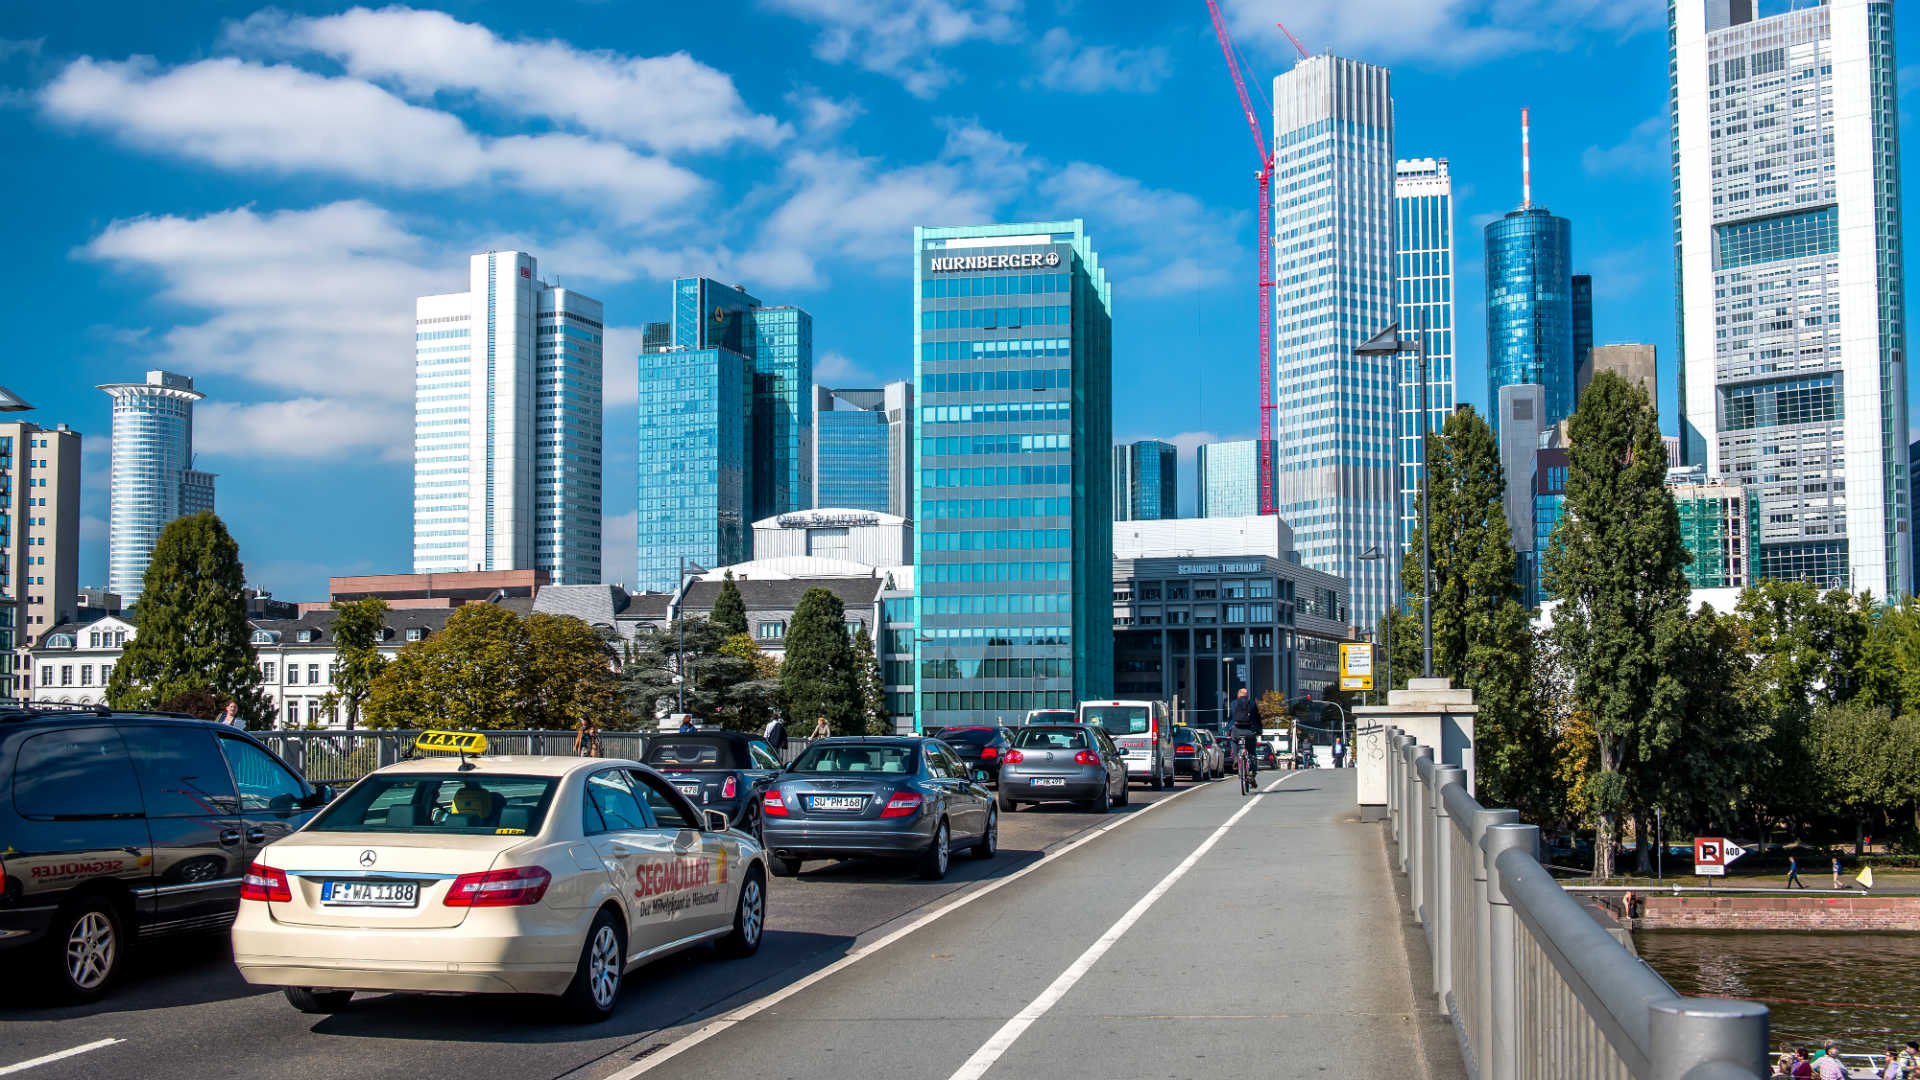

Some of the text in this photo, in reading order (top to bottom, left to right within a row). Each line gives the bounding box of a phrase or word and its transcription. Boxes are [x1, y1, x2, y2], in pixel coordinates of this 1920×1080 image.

[426, 733, 469, 746] TAXI
[815, 797, 826, 806] SU
[634, 856, 710, 898] SEGMÜLLER
[331, 883, 342, 899] F
